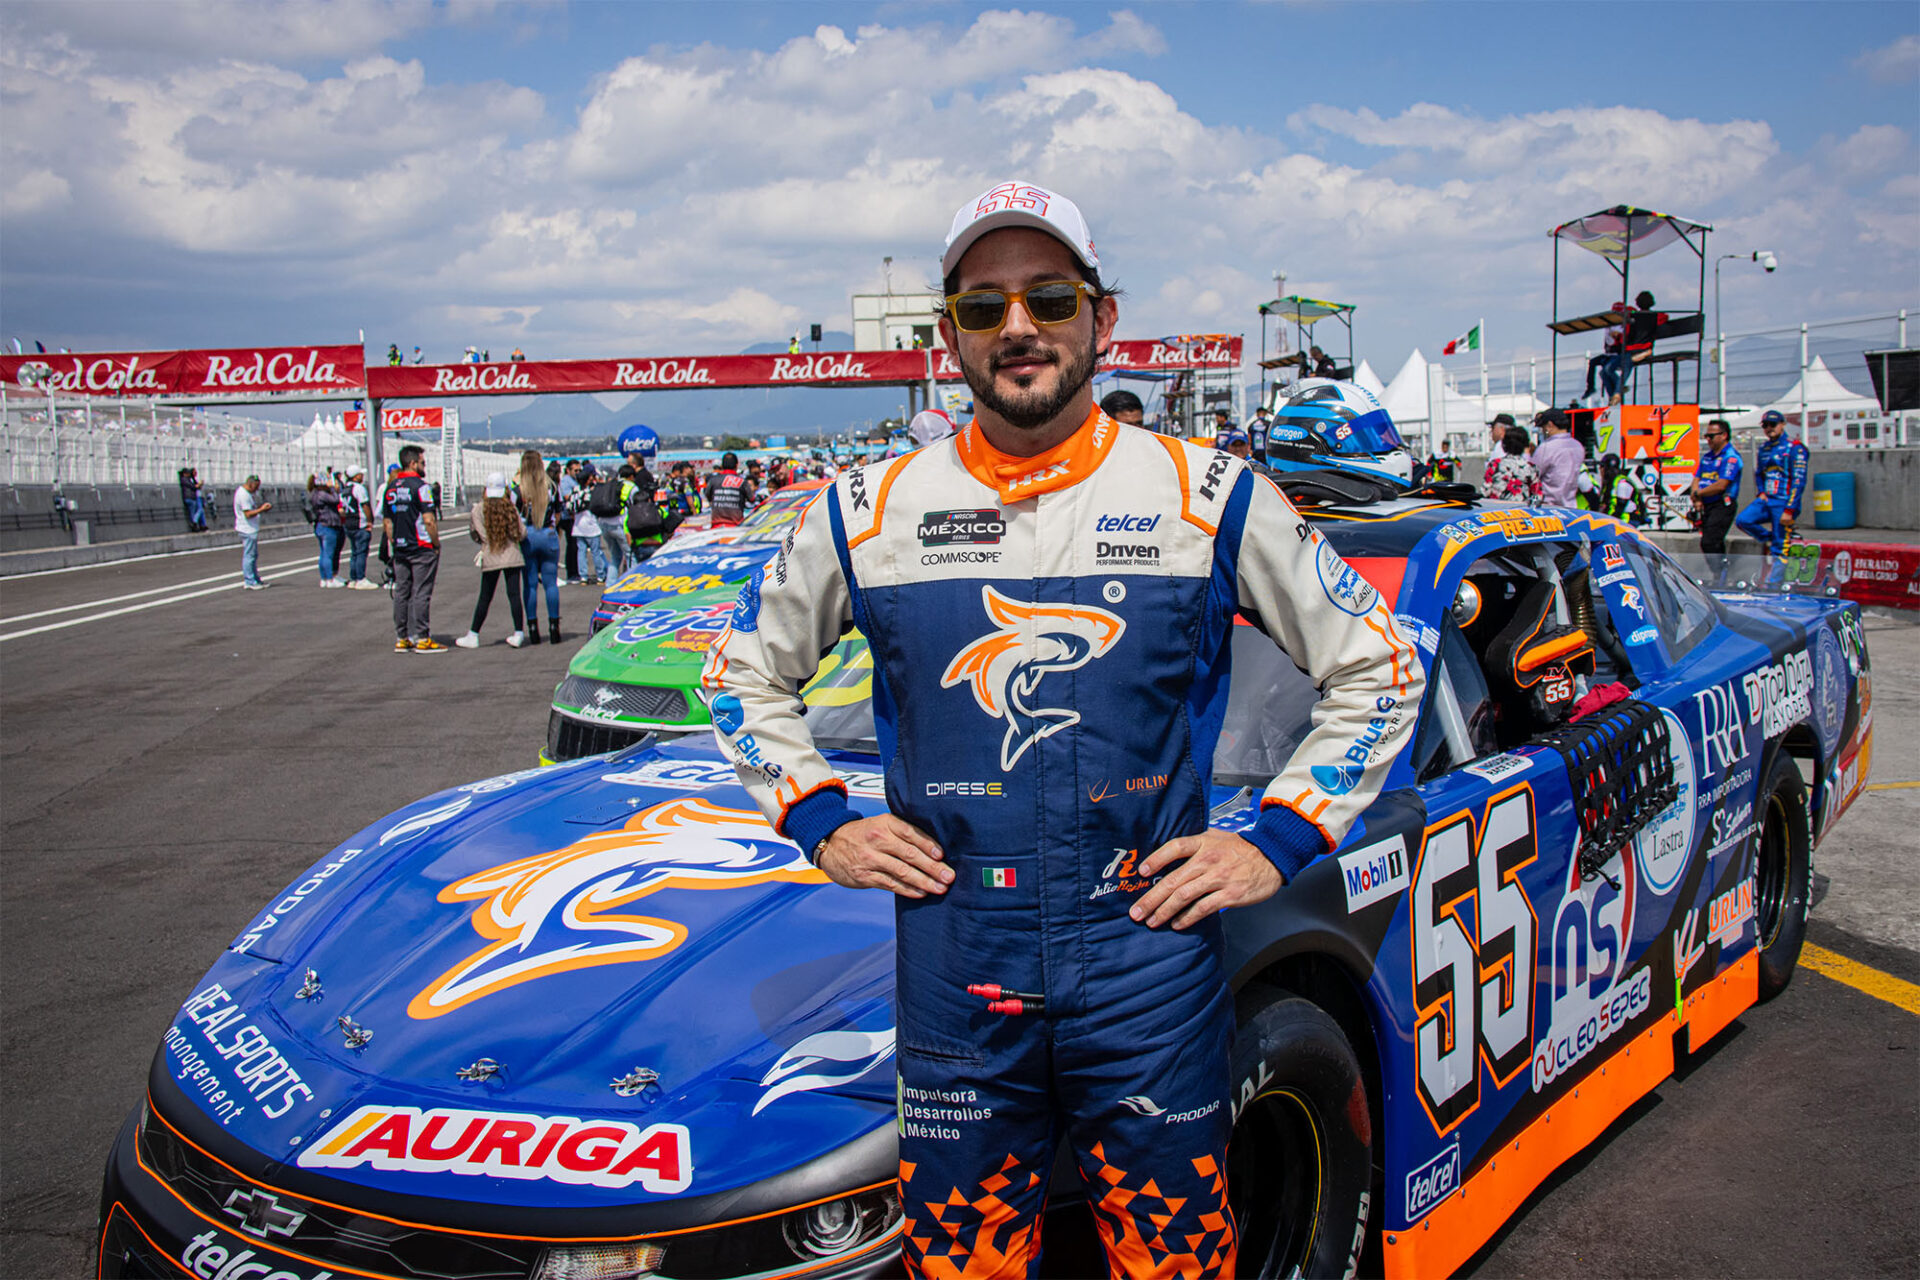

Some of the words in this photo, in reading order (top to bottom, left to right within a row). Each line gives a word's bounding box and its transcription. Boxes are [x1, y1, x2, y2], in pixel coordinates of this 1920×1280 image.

[1335, 423, 1353, 440] 55
[1598, 425, 1614, 453] 7
[1656, 424, 1692, 452] 7
[1008, 458, 1071, 492] HRX
[920, 521, 1004, 537] MÉXICO
[1096, 513, 1162, 532] telcel
[921, 551, 1001, 566] COMMSCOPE
[1096, 541, 1160, 558] Driven
[1096, 559, 1133, 567] PERFORMANCE
[1134, 559, 1160, 567] PRODUCTS
[1854, 558, 1899, 571] HERALDO
[1545, 680, 1572, 703] 55
[579, 703, 622, 720] telcel
[1344, 717, 1387, 765] Blue
[926, 782, 1003, 796] DIPESE
[1126, 774, 1168, 791] URLIN
[1653, 829, 1684, 861] Lastra
[1346, 857, 1388, 897] Mobil
[231, 849, 363, 955] PRODAR
[1709, 880, 1752, 933] URLIN
[1413, 786, 1535, 1122] 55
[163, 1025, 245, 1125] management
[903, 1083, 977, 1103] Impulsora
[904, 1103, 992, 1122] Desarrollos
[1166, 1100, 1220, 1124] PRODAR
[907, 1122, 961, 1140] México
[342, 1112, 682, 1183] AURIGA
[1408, 1149, 1457, 1214] telcel
[182, 1230, 333, 1280] telc
